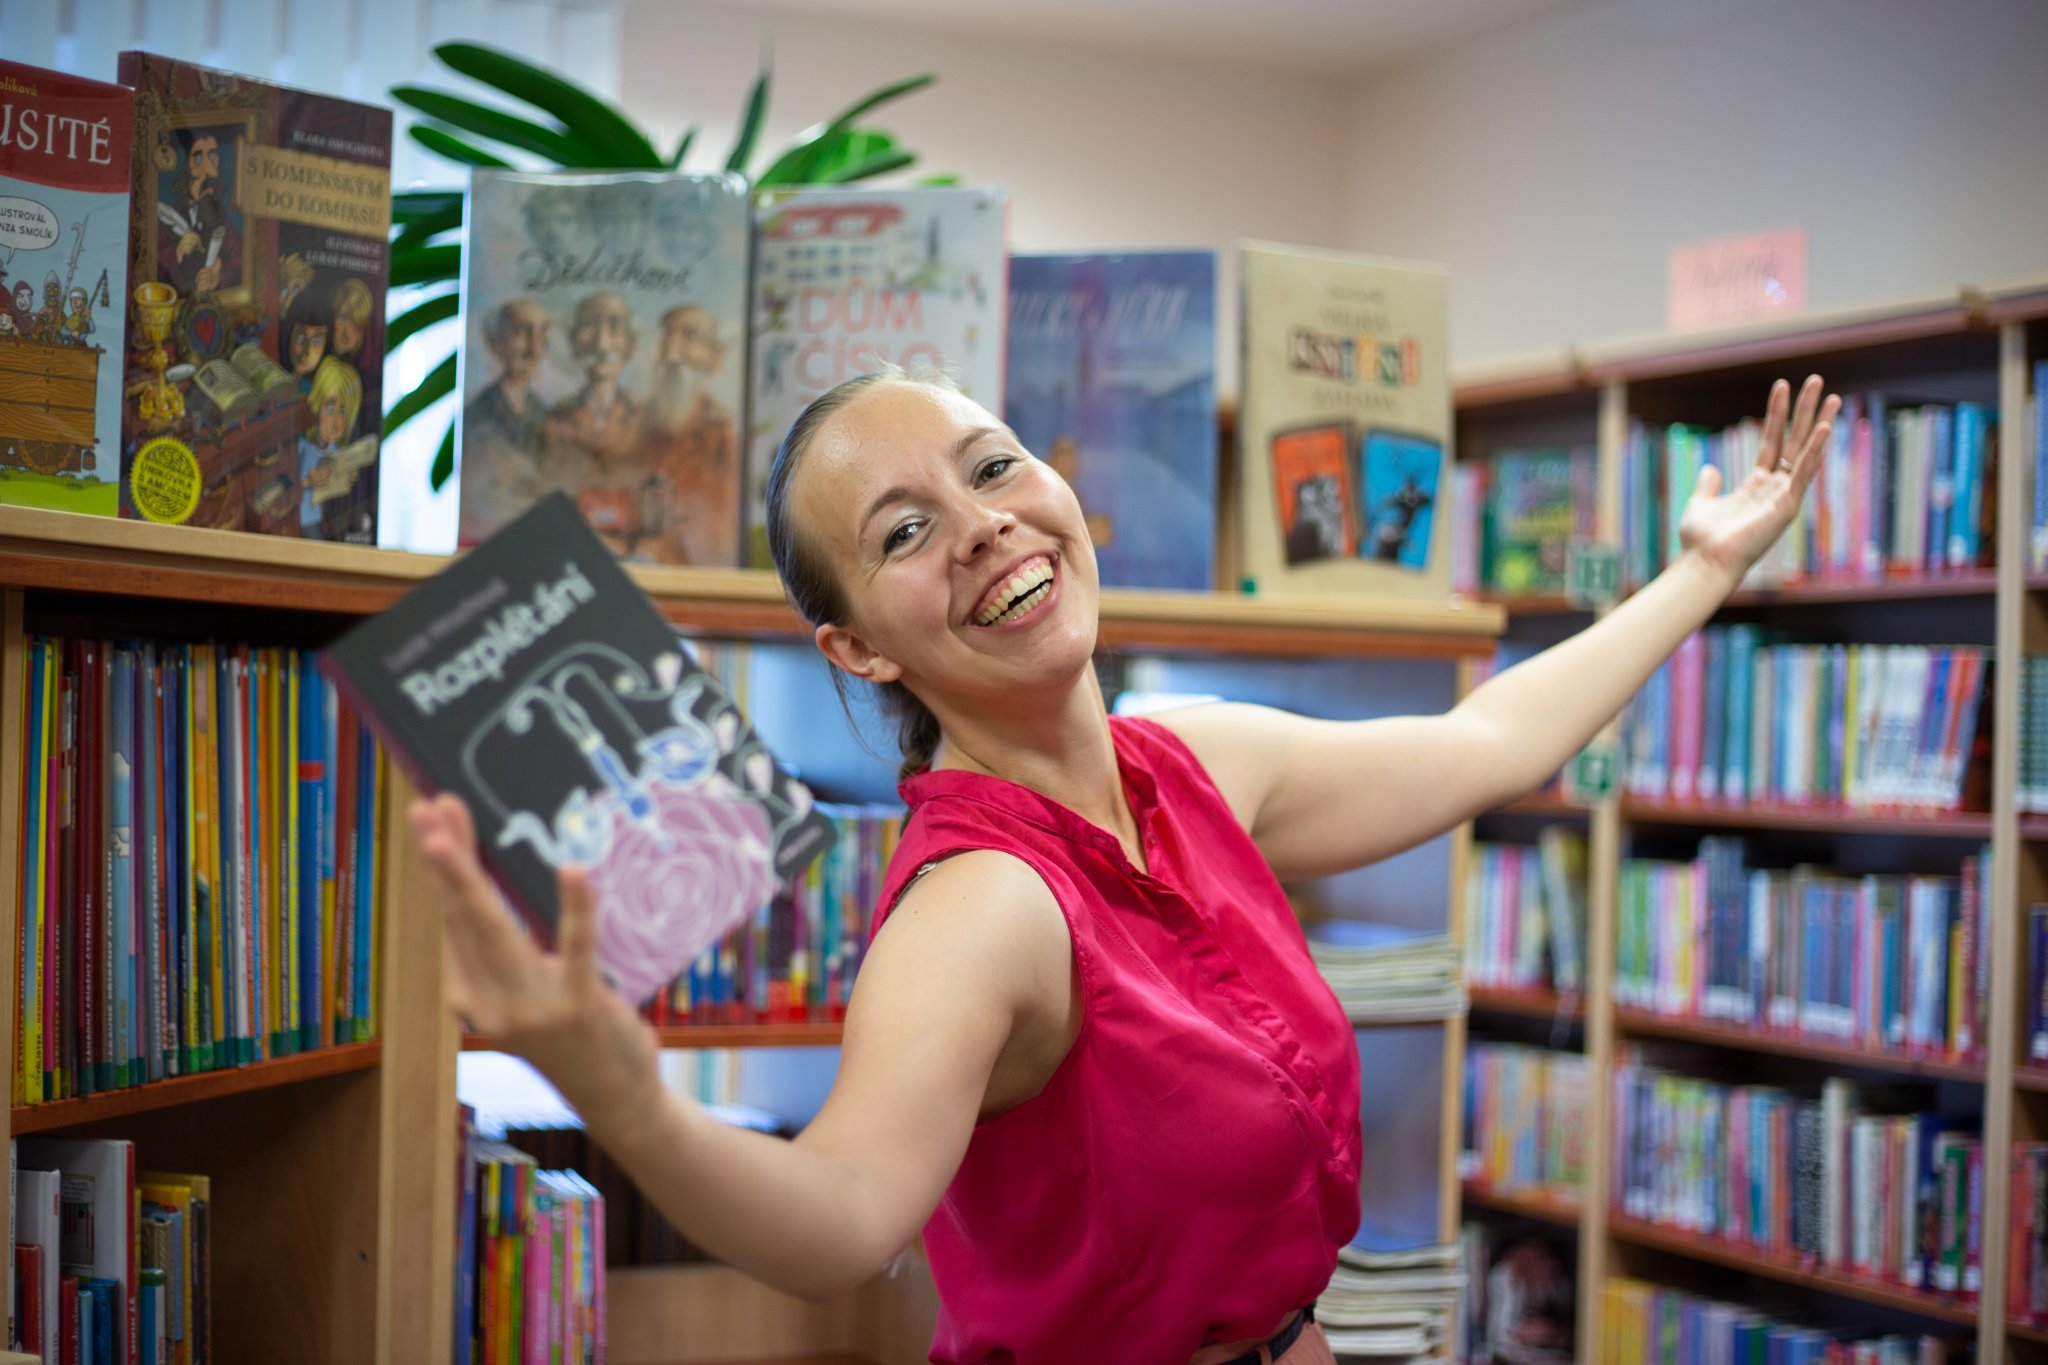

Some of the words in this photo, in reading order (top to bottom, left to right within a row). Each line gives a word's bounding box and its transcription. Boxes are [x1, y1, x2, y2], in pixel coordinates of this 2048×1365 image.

[247, 157, 257, 175] S
[265, 188, 294, 209] DO
[298, 193, 383, 225] KOMIKSU
[19, 226, 53, 239] SMOLÍK
[800, 276, 925, 334] DŮM
